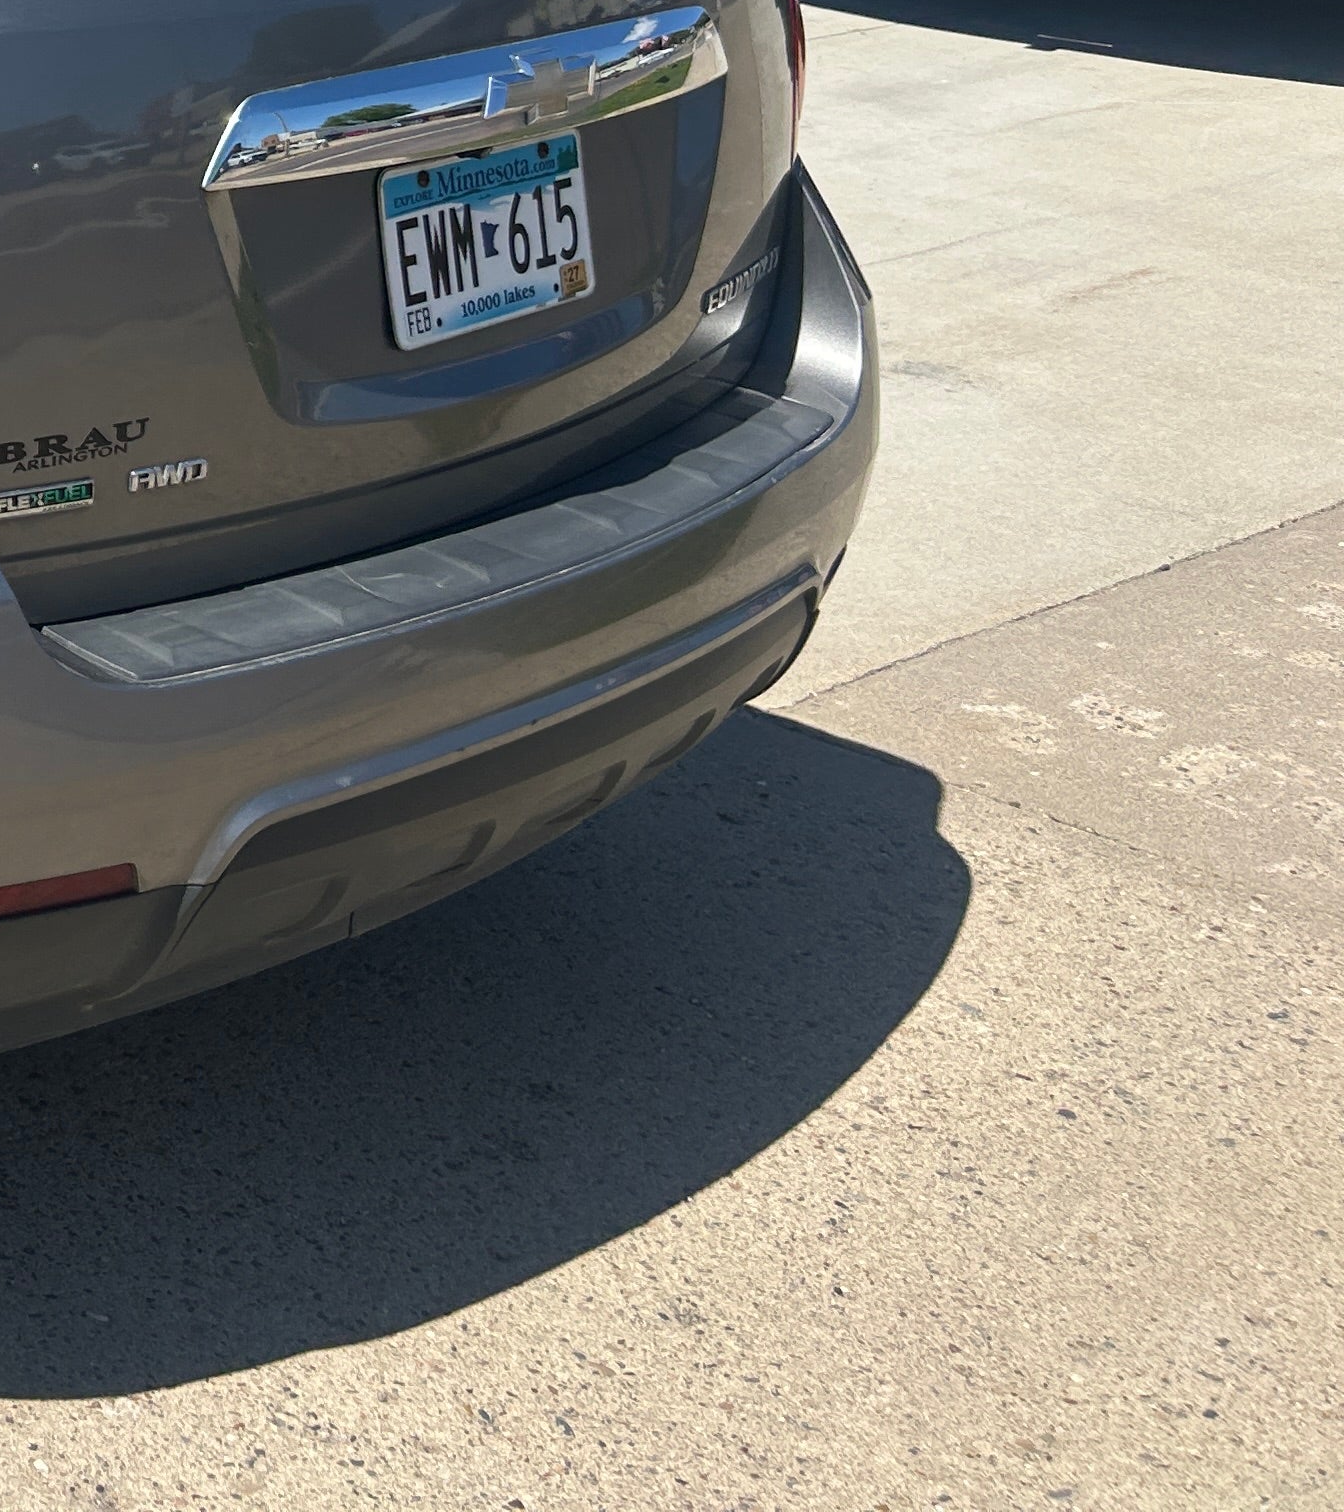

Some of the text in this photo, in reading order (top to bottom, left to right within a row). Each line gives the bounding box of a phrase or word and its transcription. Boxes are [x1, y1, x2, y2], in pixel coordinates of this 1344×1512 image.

[393, 157, 556, 209] EXPLORE Minnesota.com
[396, 177, 578, 307] EWM 615
[567, 265, 579, 283] 27
[462, 285, 536, 318] 10,000 lakes
[407, 307, 432, 337] FEB
[13, 442, 128, 473] ARLINGTON
[128, 458, 208, 492] AWD
